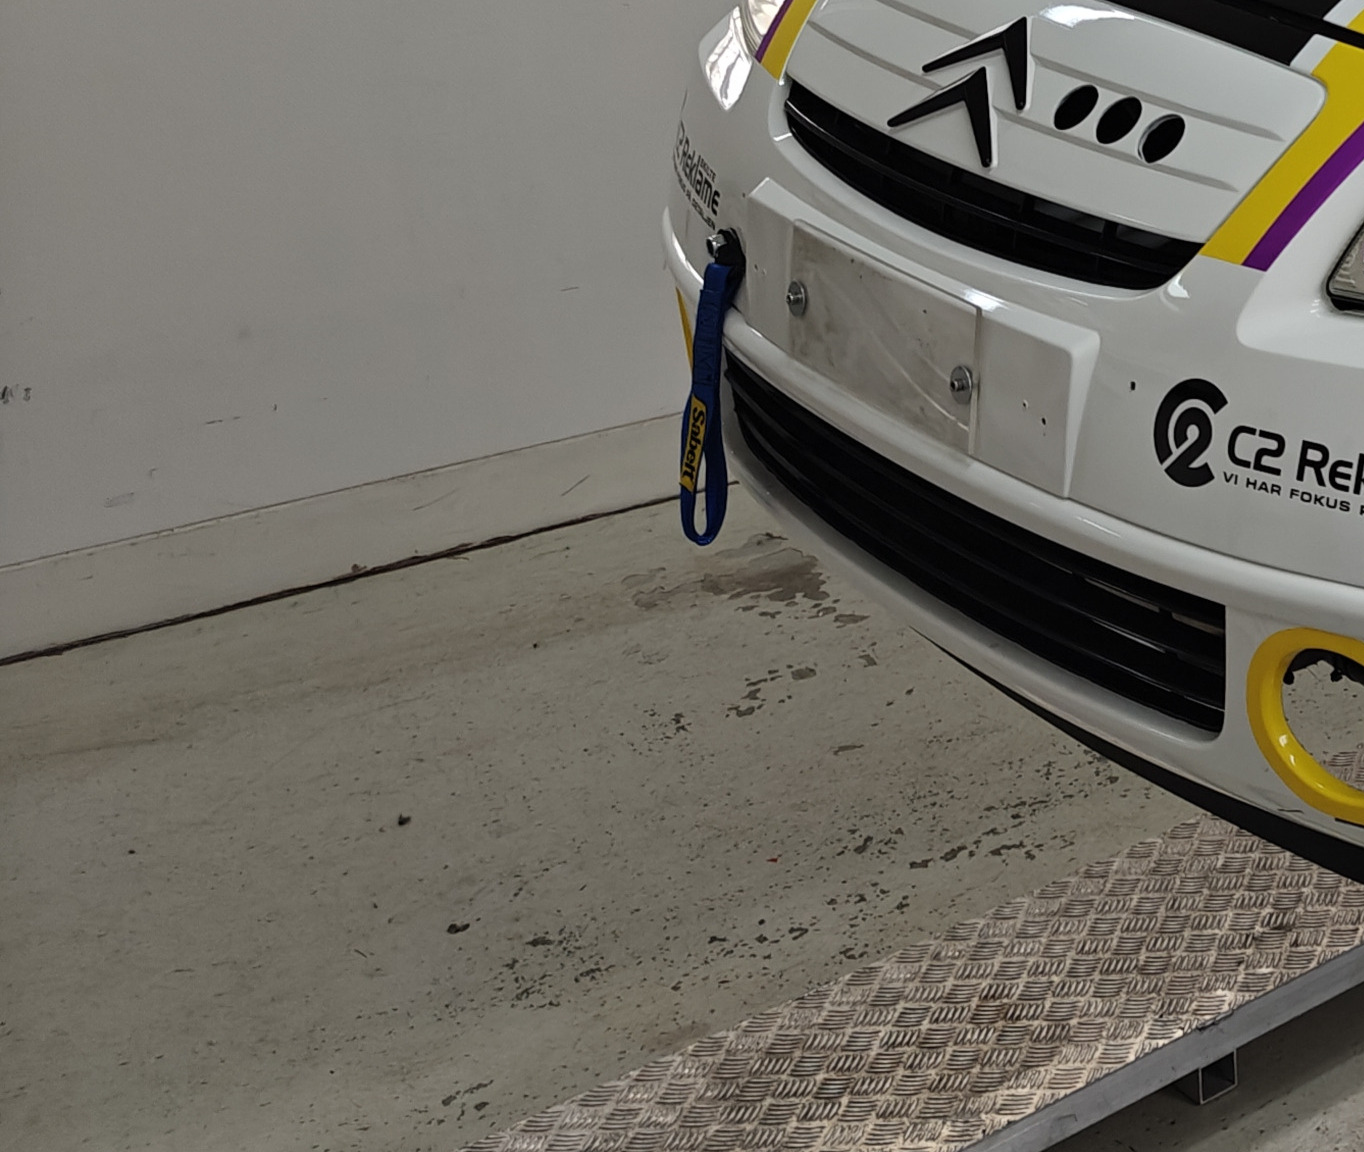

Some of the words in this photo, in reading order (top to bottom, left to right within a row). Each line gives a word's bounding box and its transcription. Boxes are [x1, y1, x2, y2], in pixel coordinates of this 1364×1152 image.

[1227, 425, 1285, 476] C2
[1223, 471, 1239, 485] VI
[1246, 478, 1282, 496] HAR
[1289, 488, 1351, 512] FOKUS
